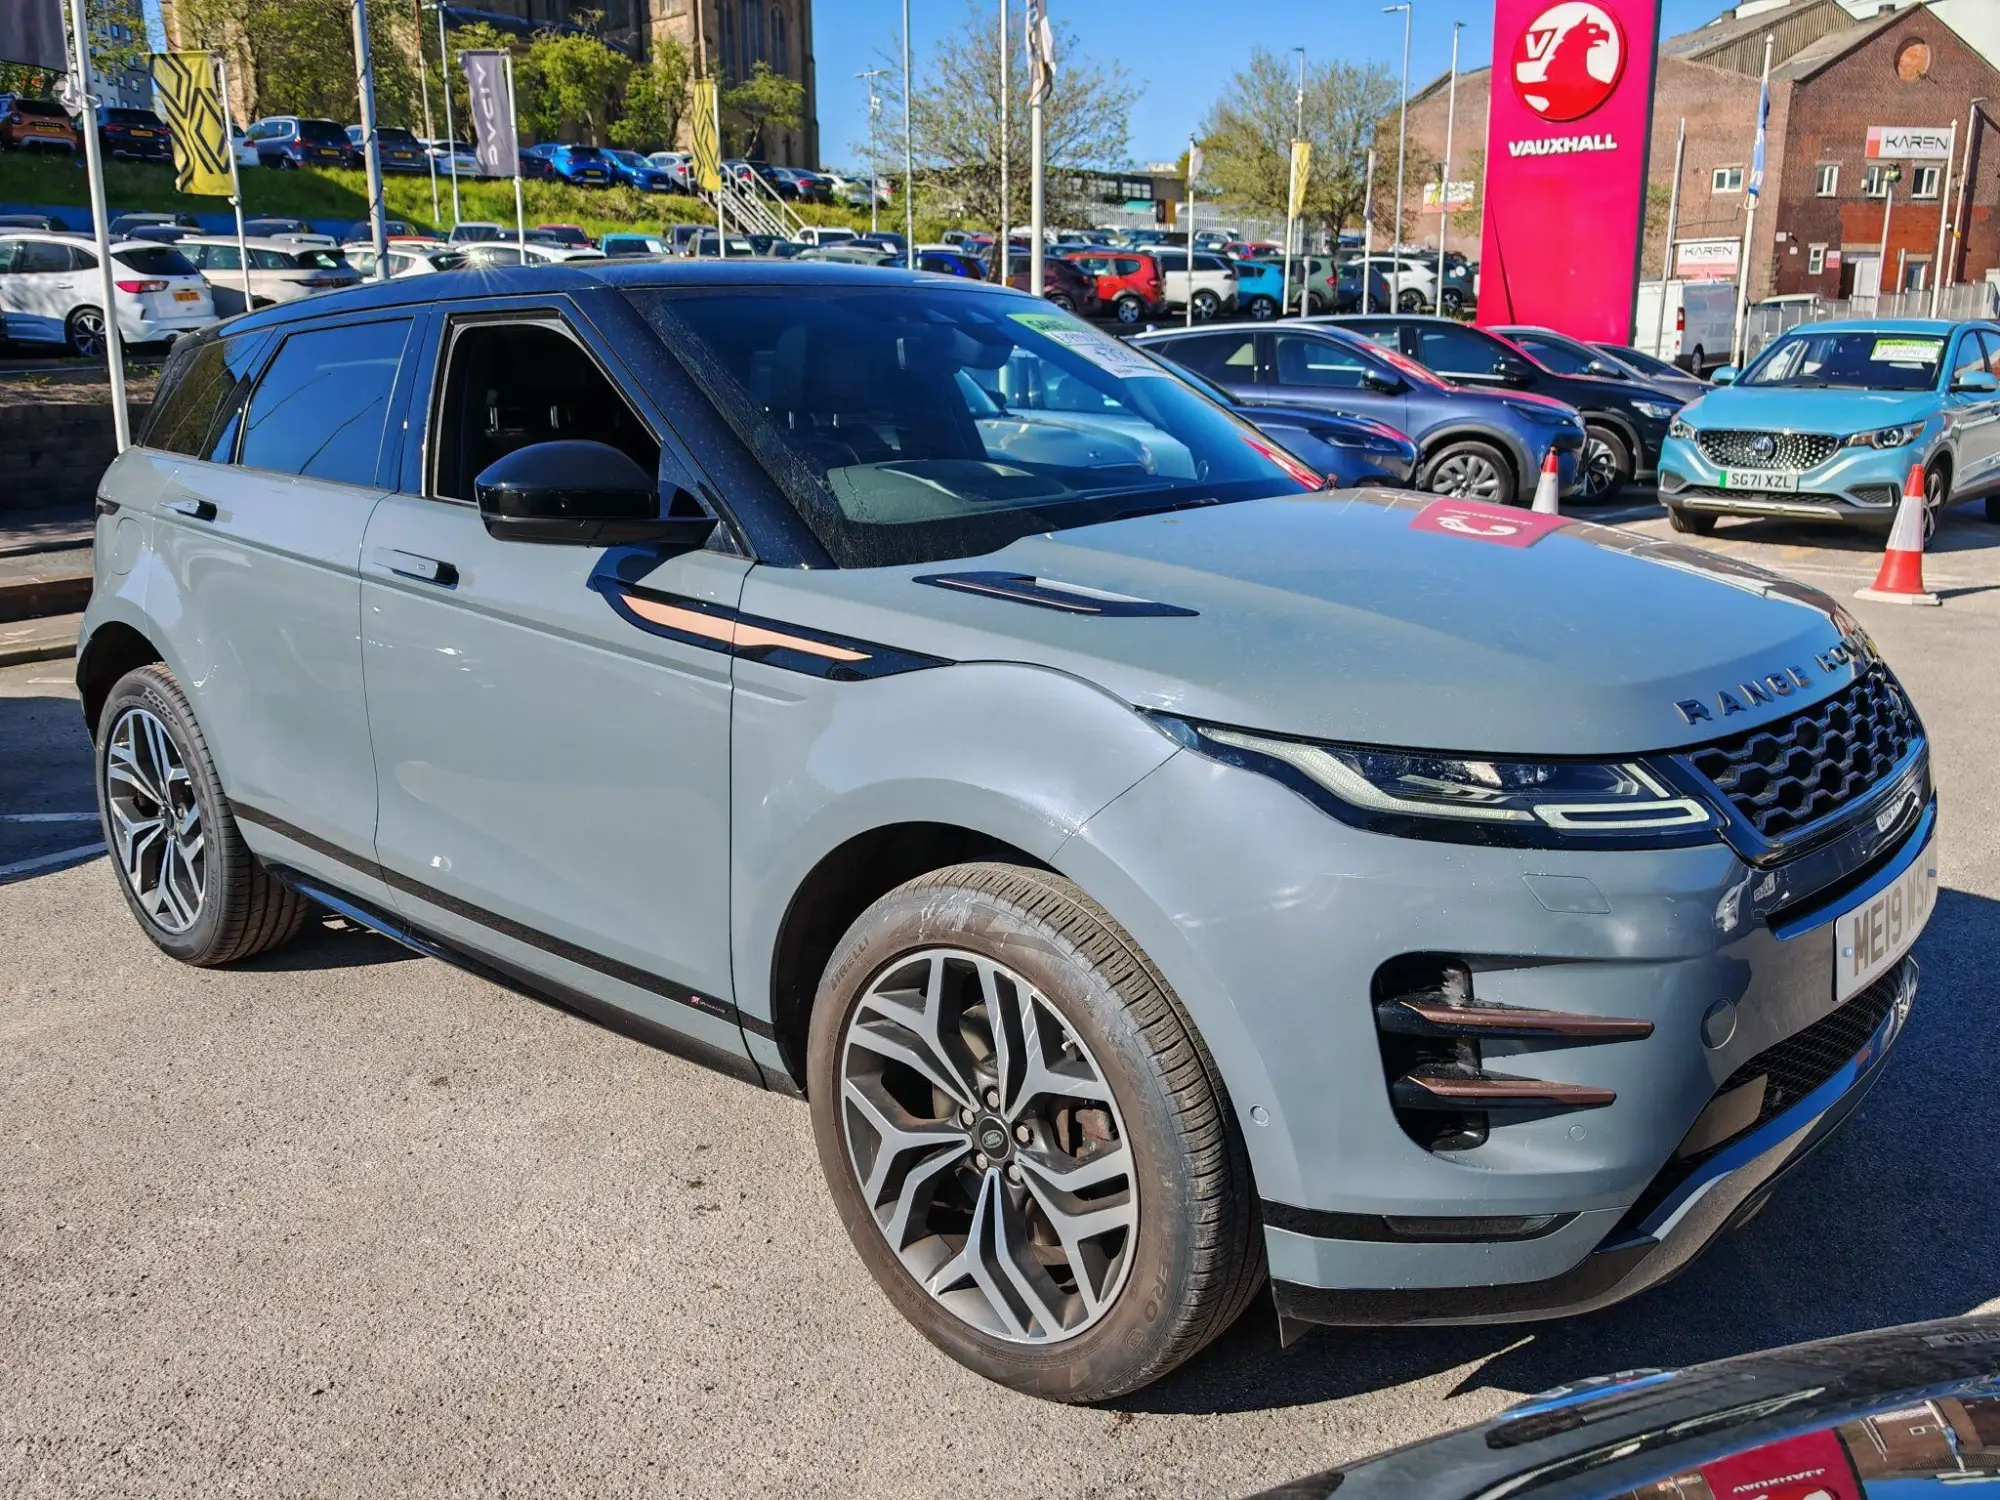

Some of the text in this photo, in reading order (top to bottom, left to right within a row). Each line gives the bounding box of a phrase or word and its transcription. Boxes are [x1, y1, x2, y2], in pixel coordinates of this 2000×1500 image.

[1508, 133, 1618, 157] VAUXHALL
[1885, 135, 1948, 150] KAREN
[1684, 245, 1733, 257] KAREN
[1731, 473, 1792, 488] SG71 XZL
[1673, 664, 1811, 726] RANGE
[1854, 885, 1903, 977] ME19
